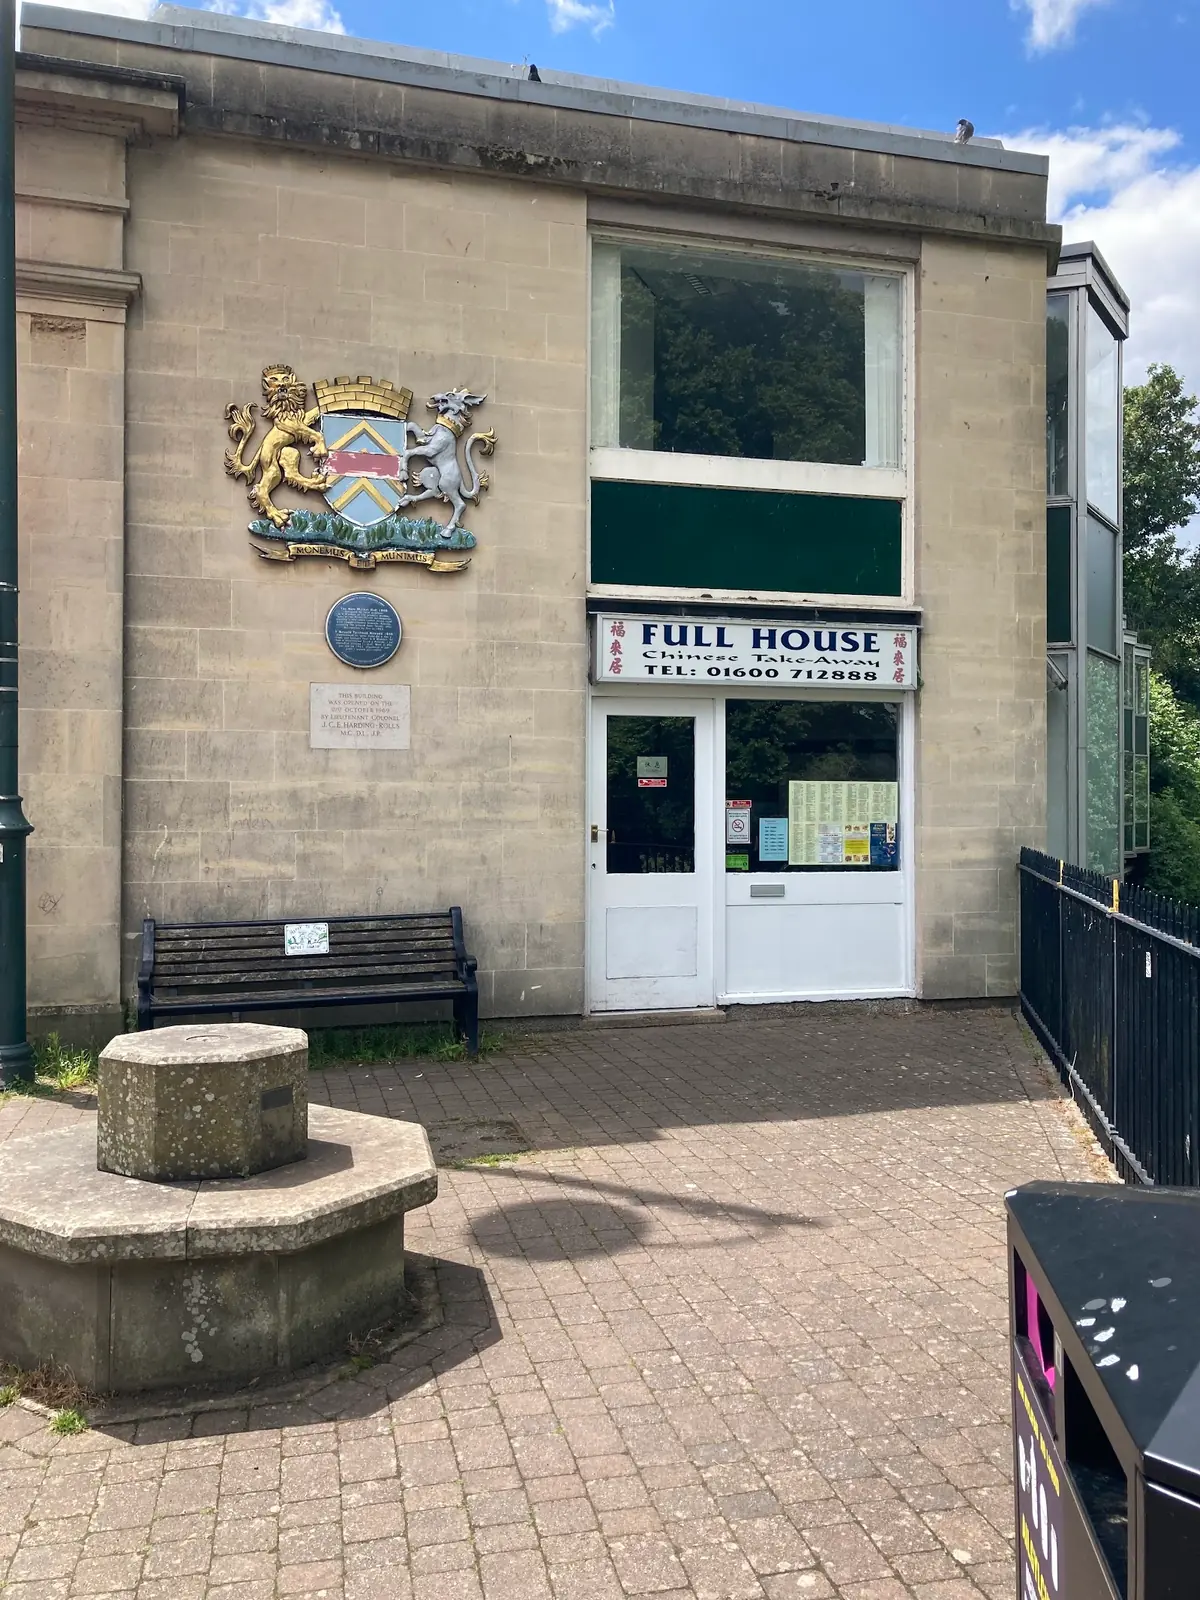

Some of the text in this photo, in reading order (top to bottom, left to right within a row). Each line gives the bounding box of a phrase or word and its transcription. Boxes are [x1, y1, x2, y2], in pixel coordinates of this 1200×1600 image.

[296, 545, 346, 558] MONEMUS
[381, 552, 427, 562] MUNIMUS
[642, 623, 880, 653] FULL HOUSE
[642, 650, 880, 668] Chinese Take-Away
[644, 665, 878, 681] TEL: 01600 712888
